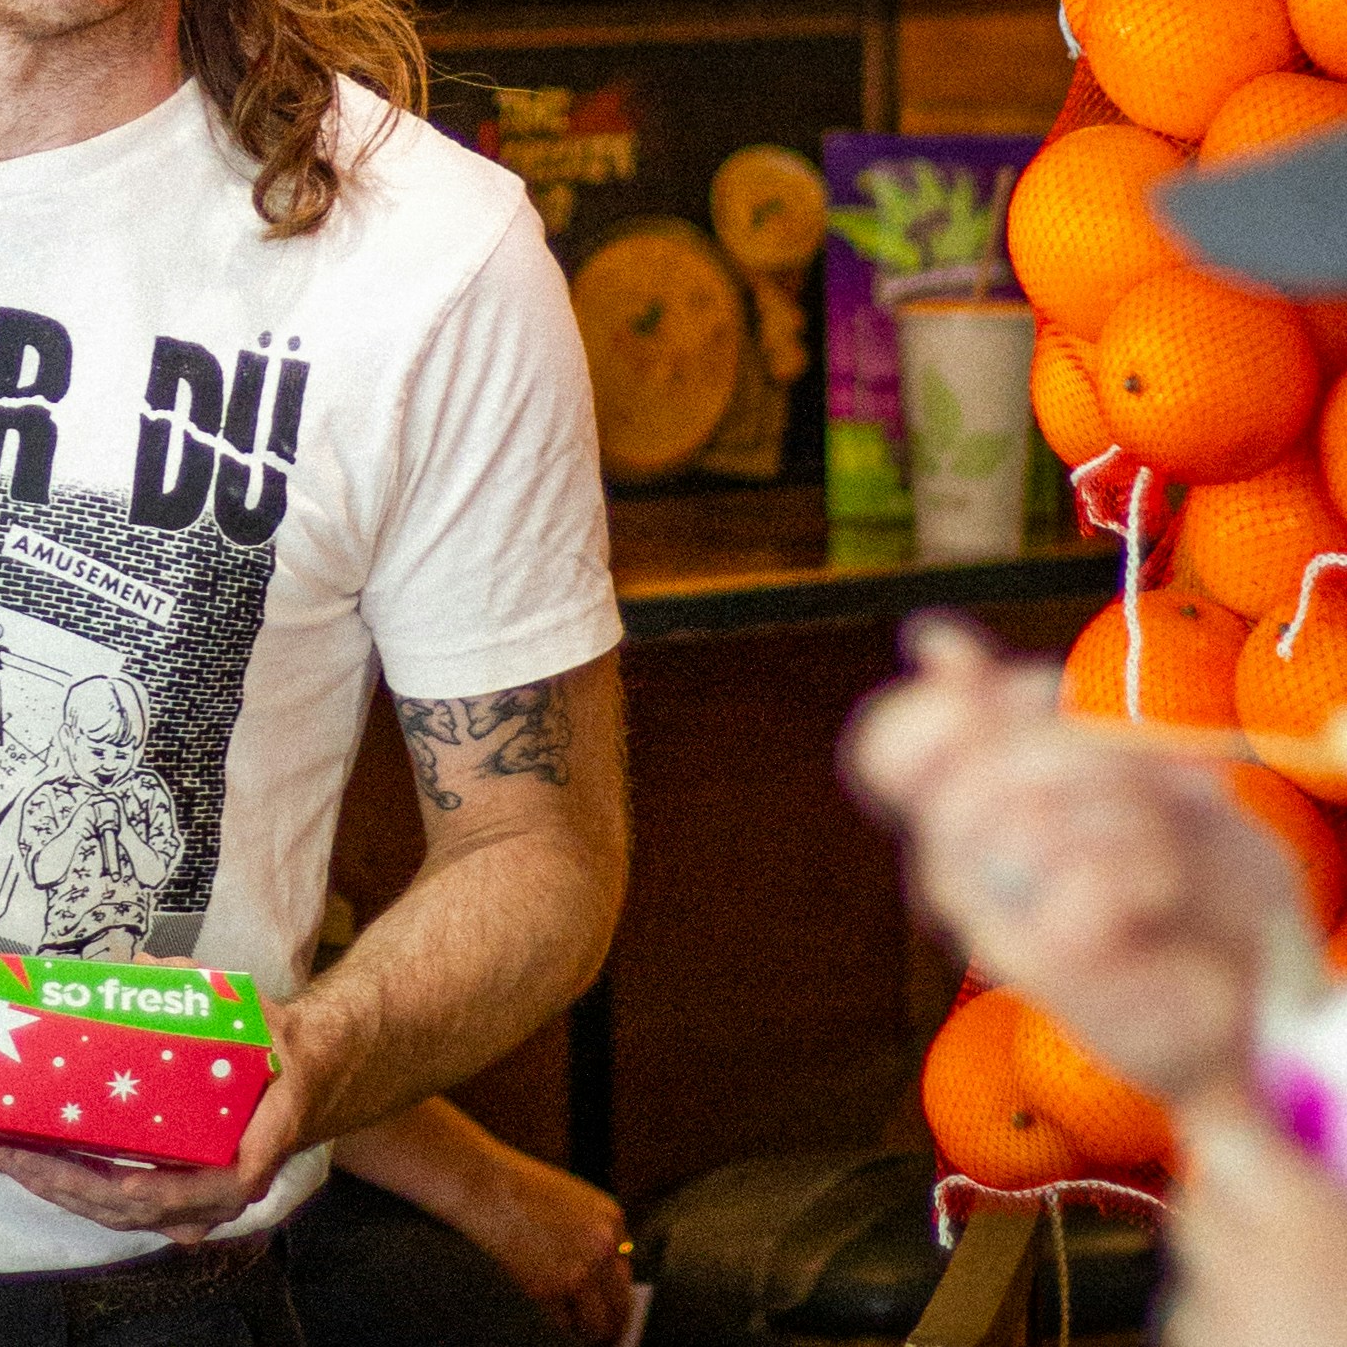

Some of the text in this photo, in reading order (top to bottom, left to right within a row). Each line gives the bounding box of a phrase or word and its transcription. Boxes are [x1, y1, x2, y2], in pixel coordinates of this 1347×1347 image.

[128, 331, 311, 548] DÜ
[12, 535, 166, 615] AMUSEMENT
[42, 977, 211, 1017] so fresh
